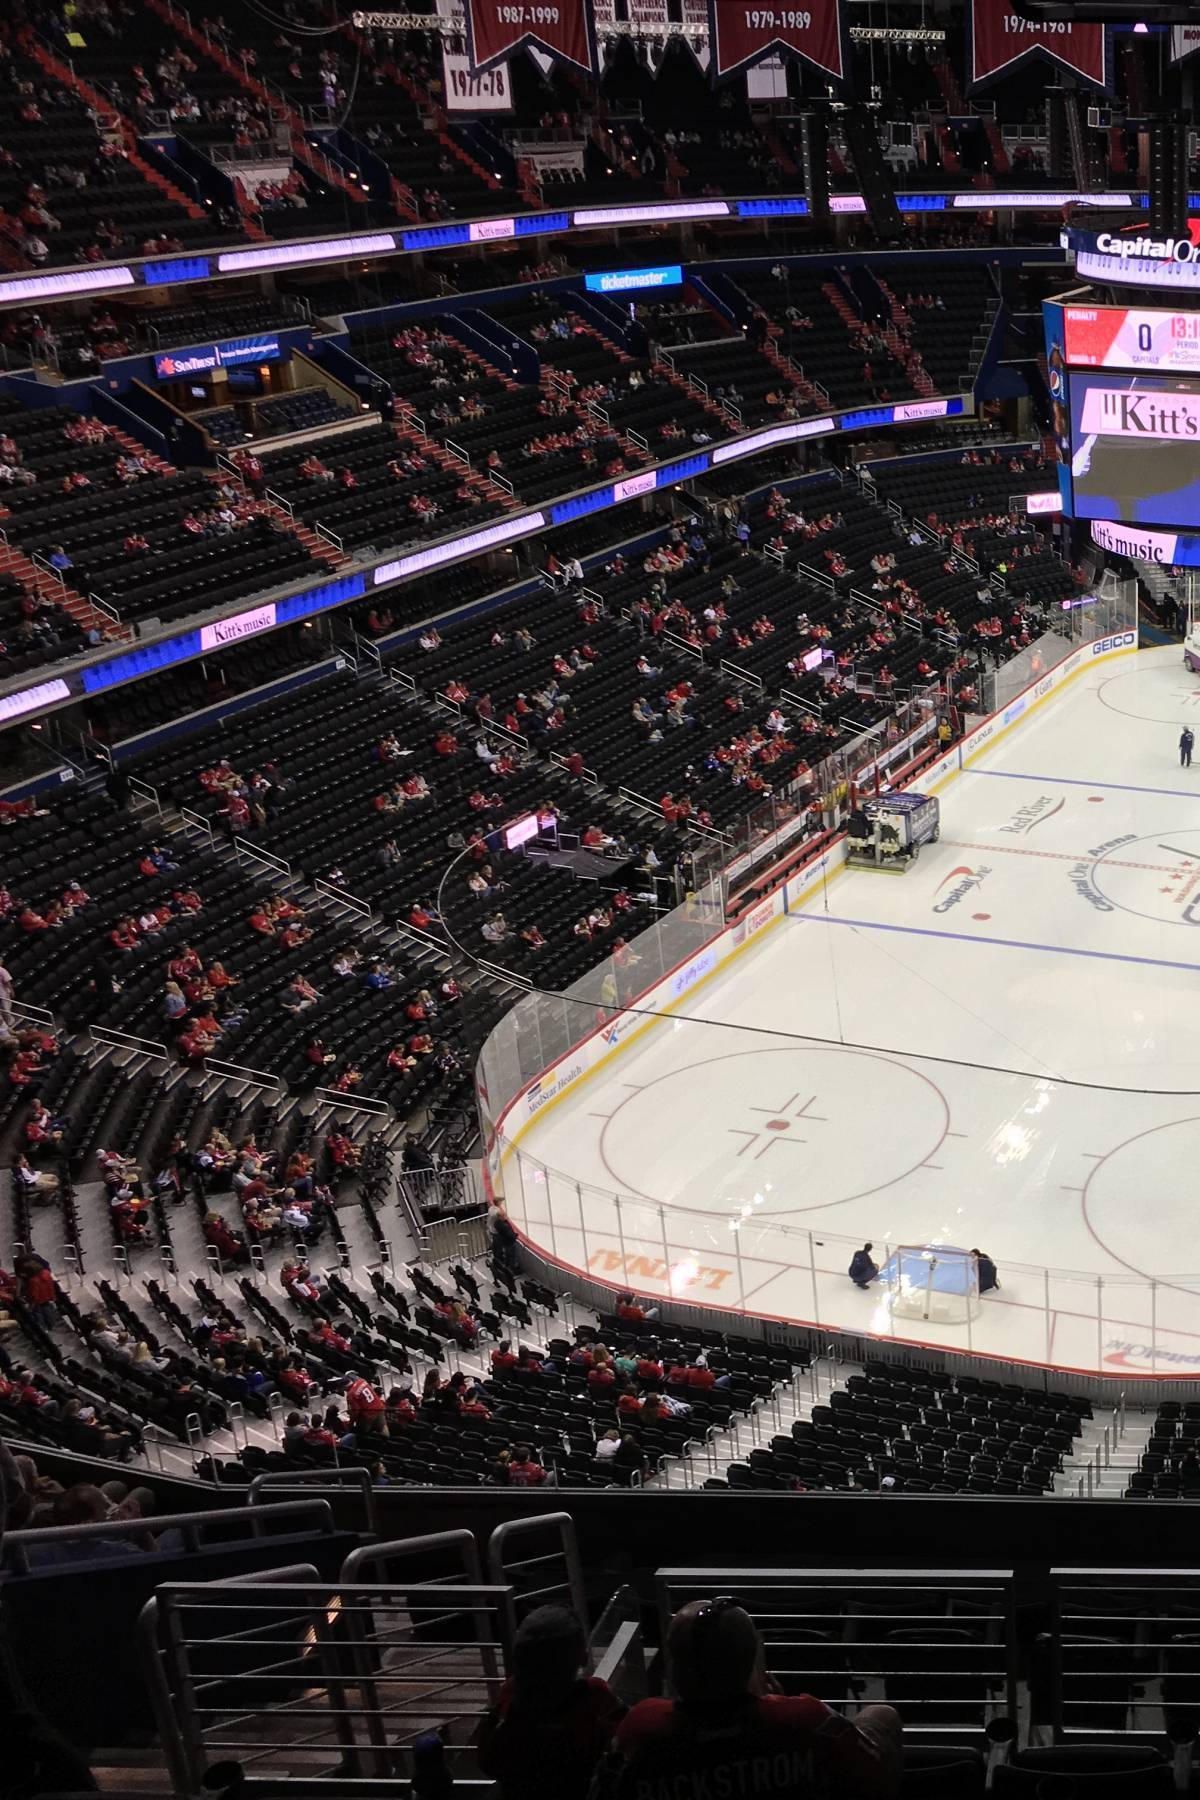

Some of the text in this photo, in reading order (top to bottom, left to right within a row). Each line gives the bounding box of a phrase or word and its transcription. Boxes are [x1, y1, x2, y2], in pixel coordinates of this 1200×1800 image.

[496, 6, 559, 24] 1987-1999
[745, 11, 811, 29] 1979-1989
[450, 70, 505, 96] 1977-78
[600, 271, 667, 290] ticketmaster
[1138, 323, 1152, 352] 0
[903, 406, 943, 418] Kitt's music
[1120, 394, 1198, 435] Kitt's
[1115, 538, 1164, 563] music
[213, 613, 271, 643] Kitt's music
[1092, 632, 1135, 656] GEICO
[1000, 795, 1053, 834] Red River
[1087, 833, 1138, 857] Arena
[528, 1065, 583, 1114] MedStar Health
[587, 1248, 734, 1291] LNA!
[362, 1387, 375, 1403] 8
